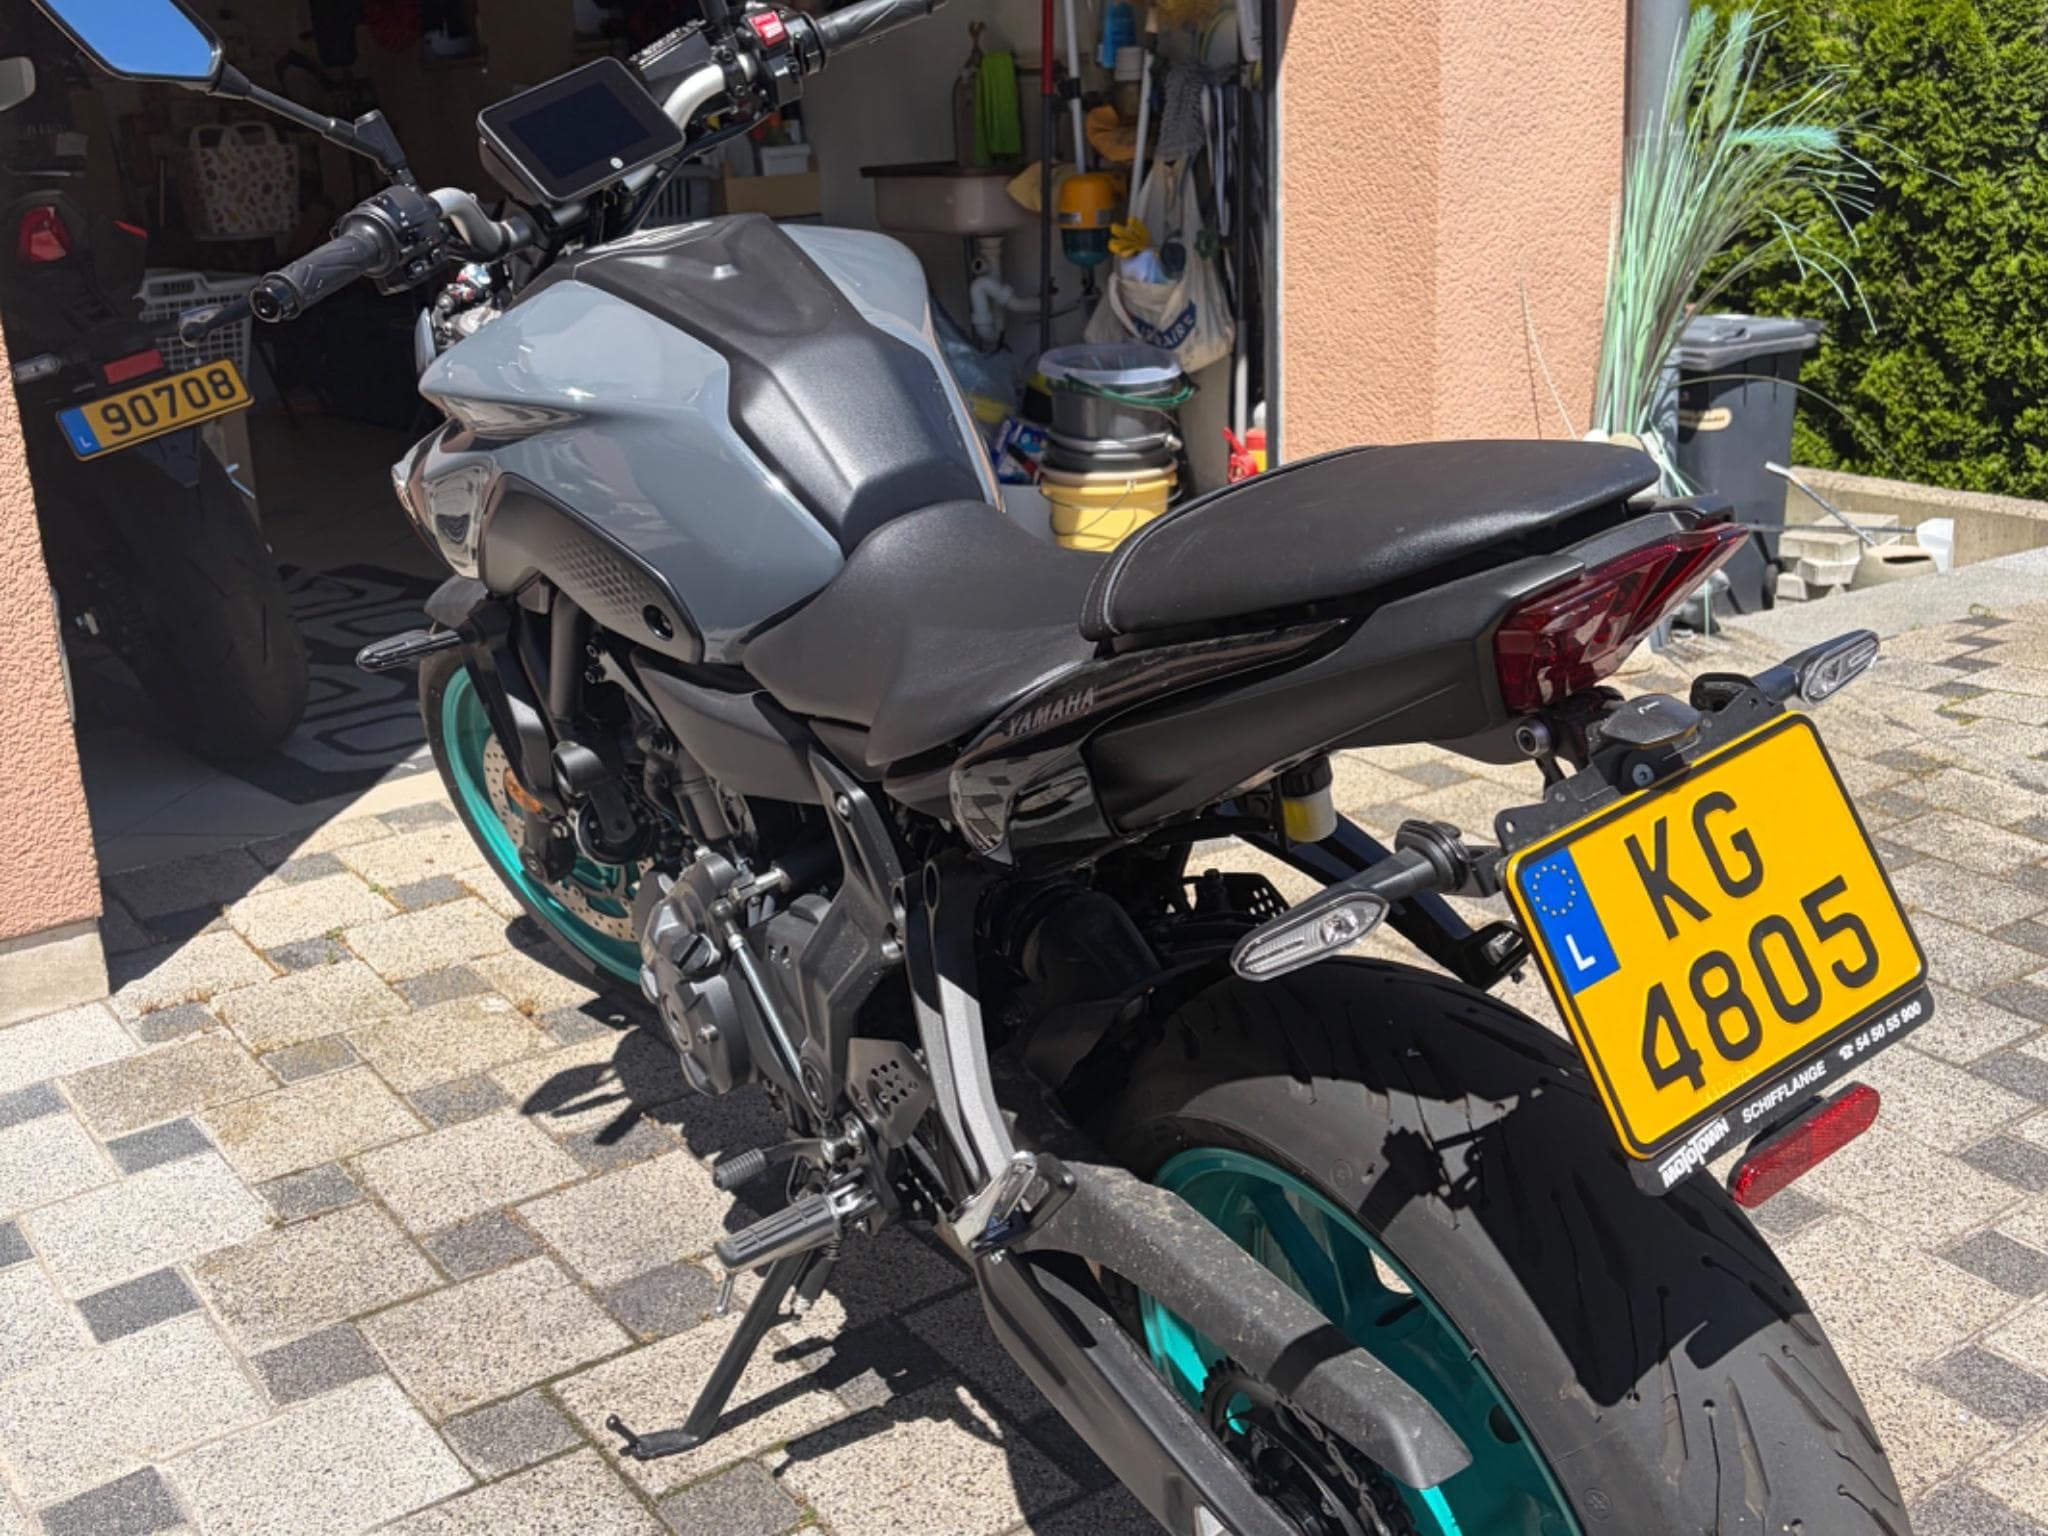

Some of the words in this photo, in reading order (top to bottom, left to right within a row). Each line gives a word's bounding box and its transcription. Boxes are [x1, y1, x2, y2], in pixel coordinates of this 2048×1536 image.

[102, 369, 236, 436] 90708
[79, 437, 92, 448] L
[1009, 687, 1094, 737] YAMAHA
[1624, 791, 1764, 940] KG
[1565, 934, 1596, 971] L
[1641, 875, 1880, 1092] 4805
[1742, 1060, 1827, 1124] SCHIFFLANGE
[1855, 1032, 1871, 1051] 54
[1870, 1023, 1887, 1042] 50
[1886, 1014, 1901, 1033] 55
[1900, 1000, 1922, 1023] 900
